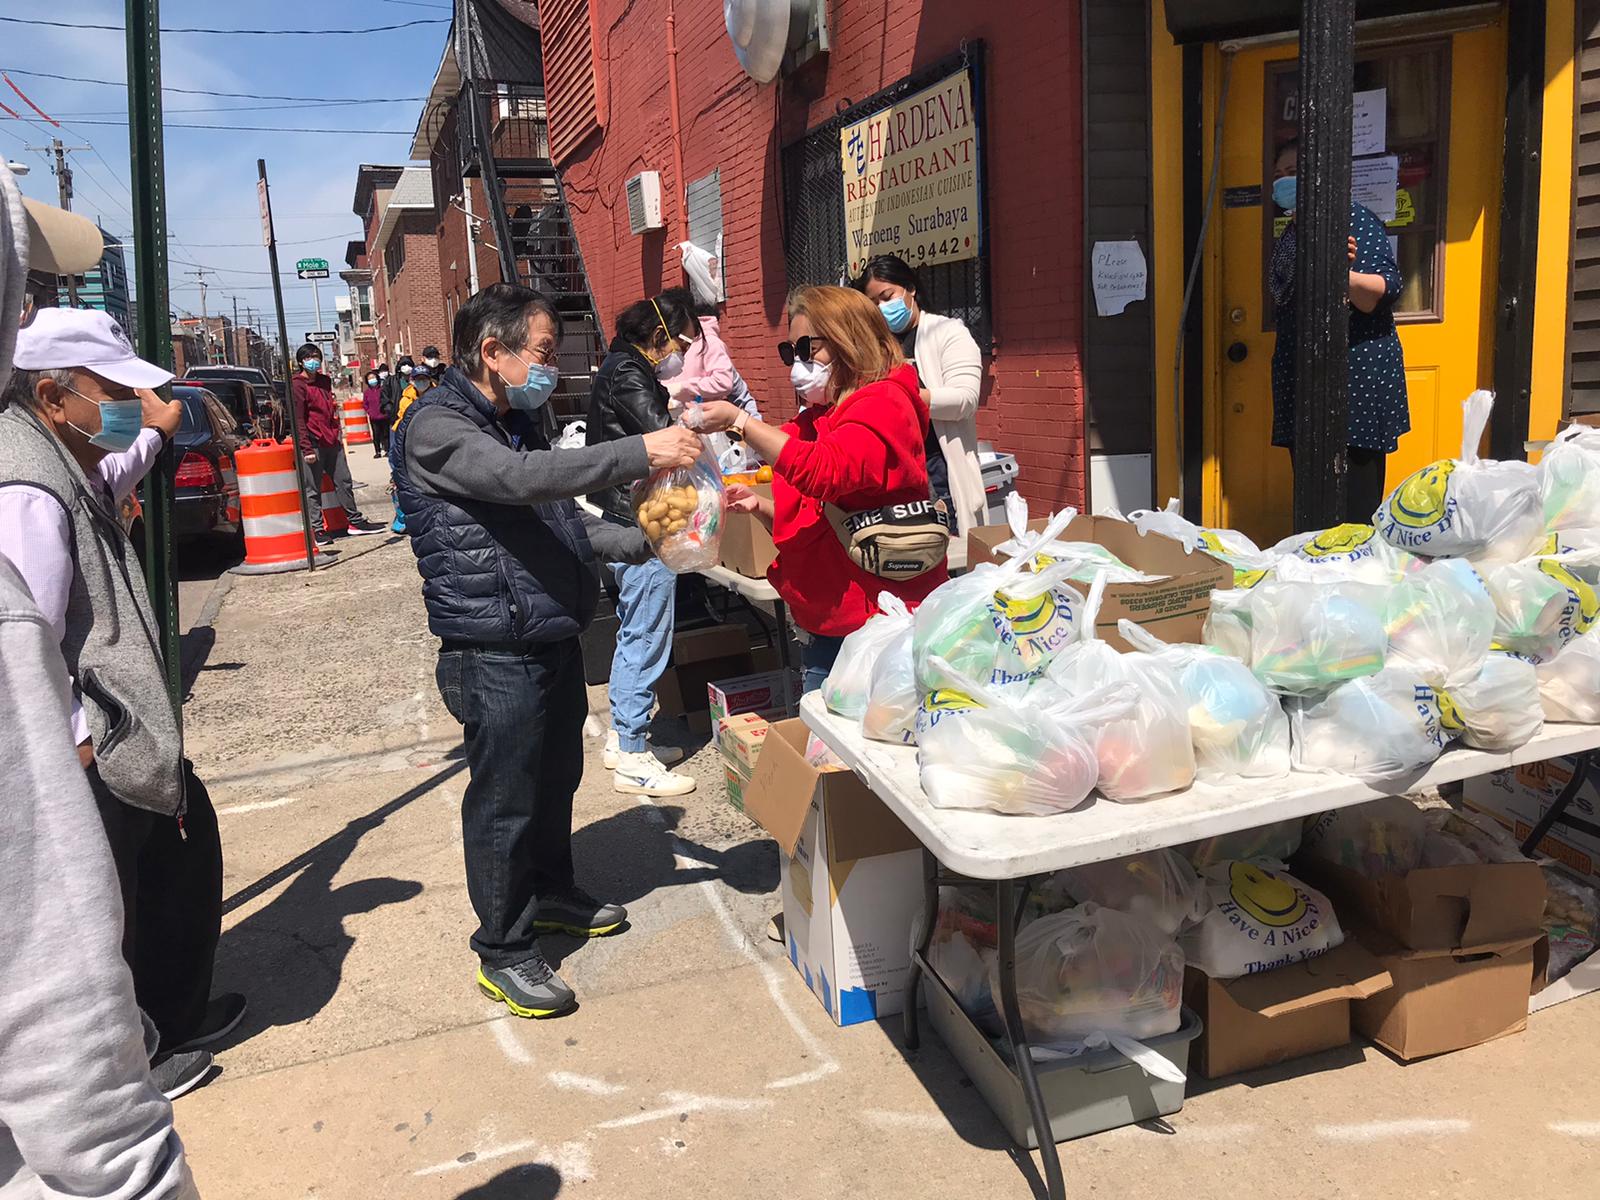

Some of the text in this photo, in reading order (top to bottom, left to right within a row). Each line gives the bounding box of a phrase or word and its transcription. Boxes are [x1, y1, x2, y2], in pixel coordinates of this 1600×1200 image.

[868, 85, 969, 163] HARDENA
[846, 137, 974, 203] RESTAURANT
[848, 170, 973, 224] AUTHENTIC INDONESIAN CUISINE
[852, 206, 969, 249] Waroeng Surabaya
[1396, 530, 1432, 547] Nice
[887, 562, 919, 570] Supreme
[1144, 591, 1179, 603] CALIFORNIA
[1027, 626, 1069, 656] Nice
[1414, 684, 1436, 738] Have
[1217, 901, 1260, 941] Have
[1264, 932, 1276, 946] A
[1283, 918, 1319, 946] Nice
[1244, 954, 1295, 974] Thank
